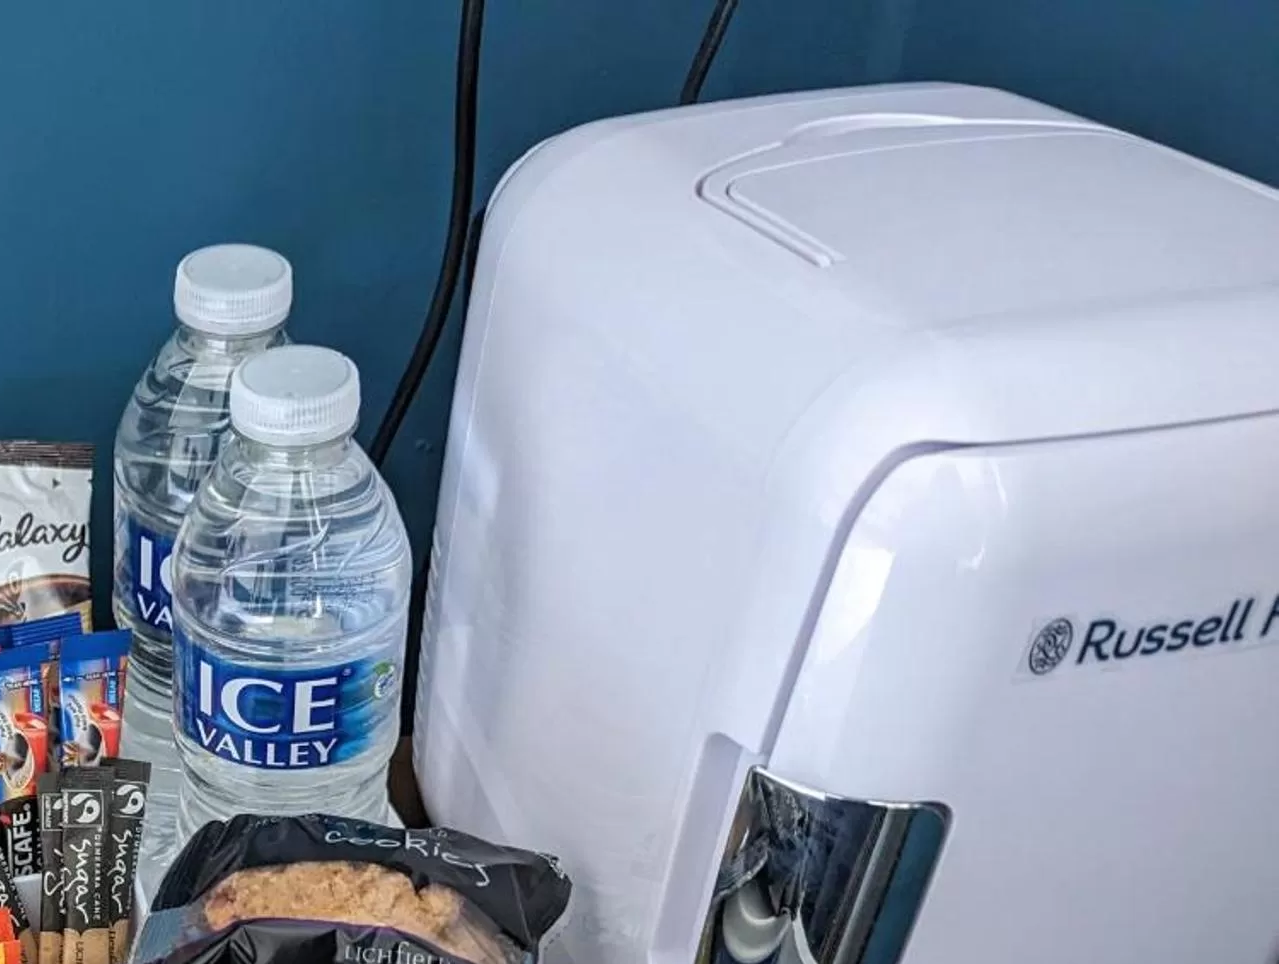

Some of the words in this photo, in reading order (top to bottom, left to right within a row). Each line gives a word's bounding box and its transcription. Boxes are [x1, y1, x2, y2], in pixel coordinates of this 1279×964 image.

[1075, 597, 1256, 665] Russell
[199, 660, 338, 735] ICE
[196, 718, 338, 767] VALLEY
[324, 830, 491, 886] cookies
